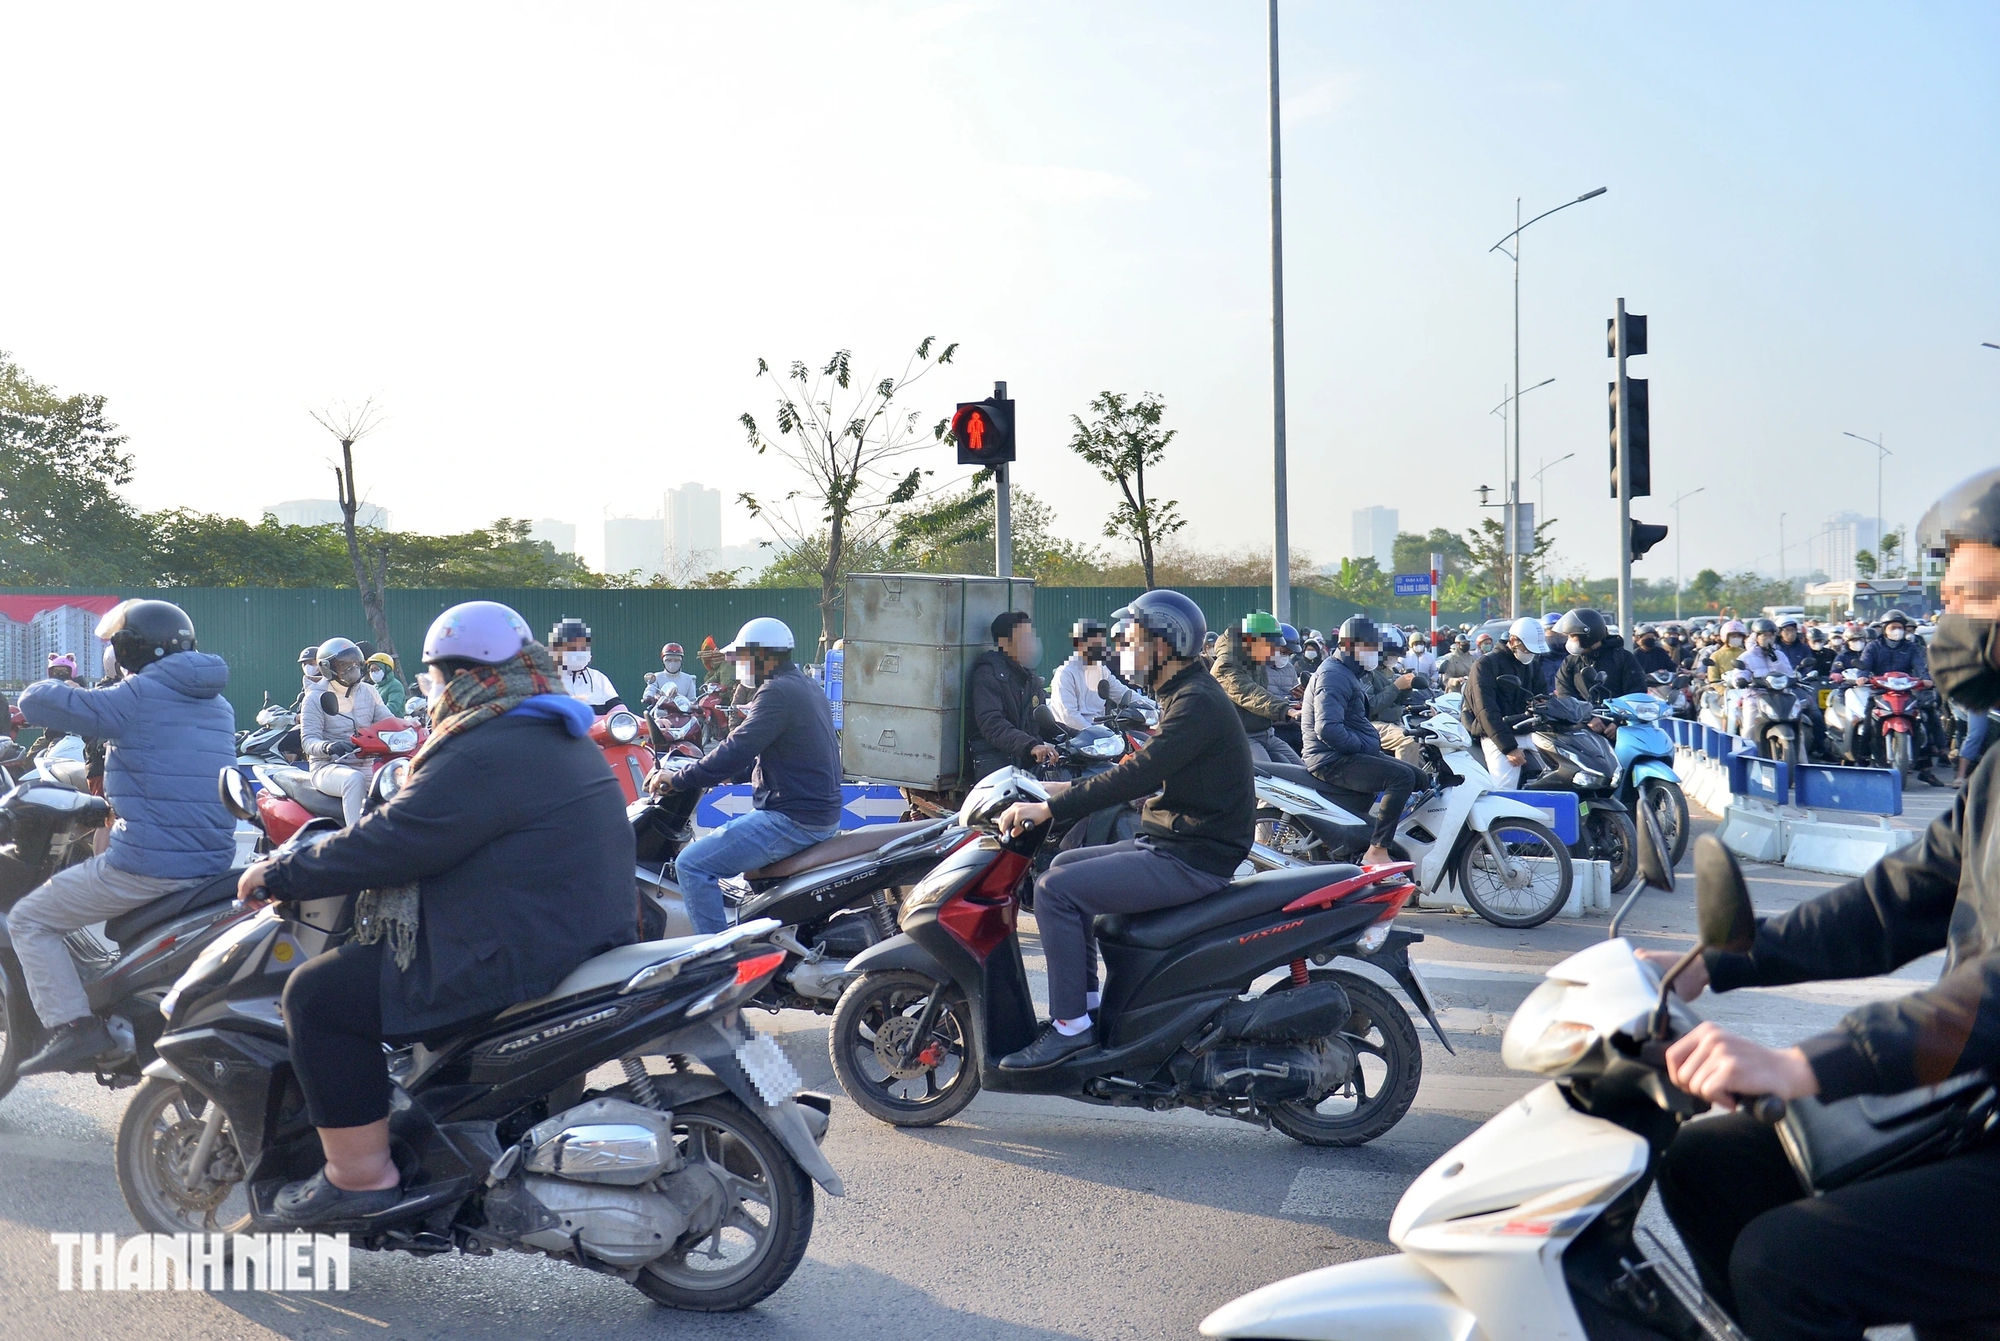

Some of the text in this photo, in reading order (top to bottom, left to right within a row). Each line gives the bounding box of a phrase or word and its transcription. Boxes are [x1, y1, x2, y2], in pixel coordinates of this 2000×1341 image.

[810, 868, 877, 896] AIR BLADE
[1239, 919, 1304, 945] VISION
[498, 1007, 618, 1053] AIR BLADE
